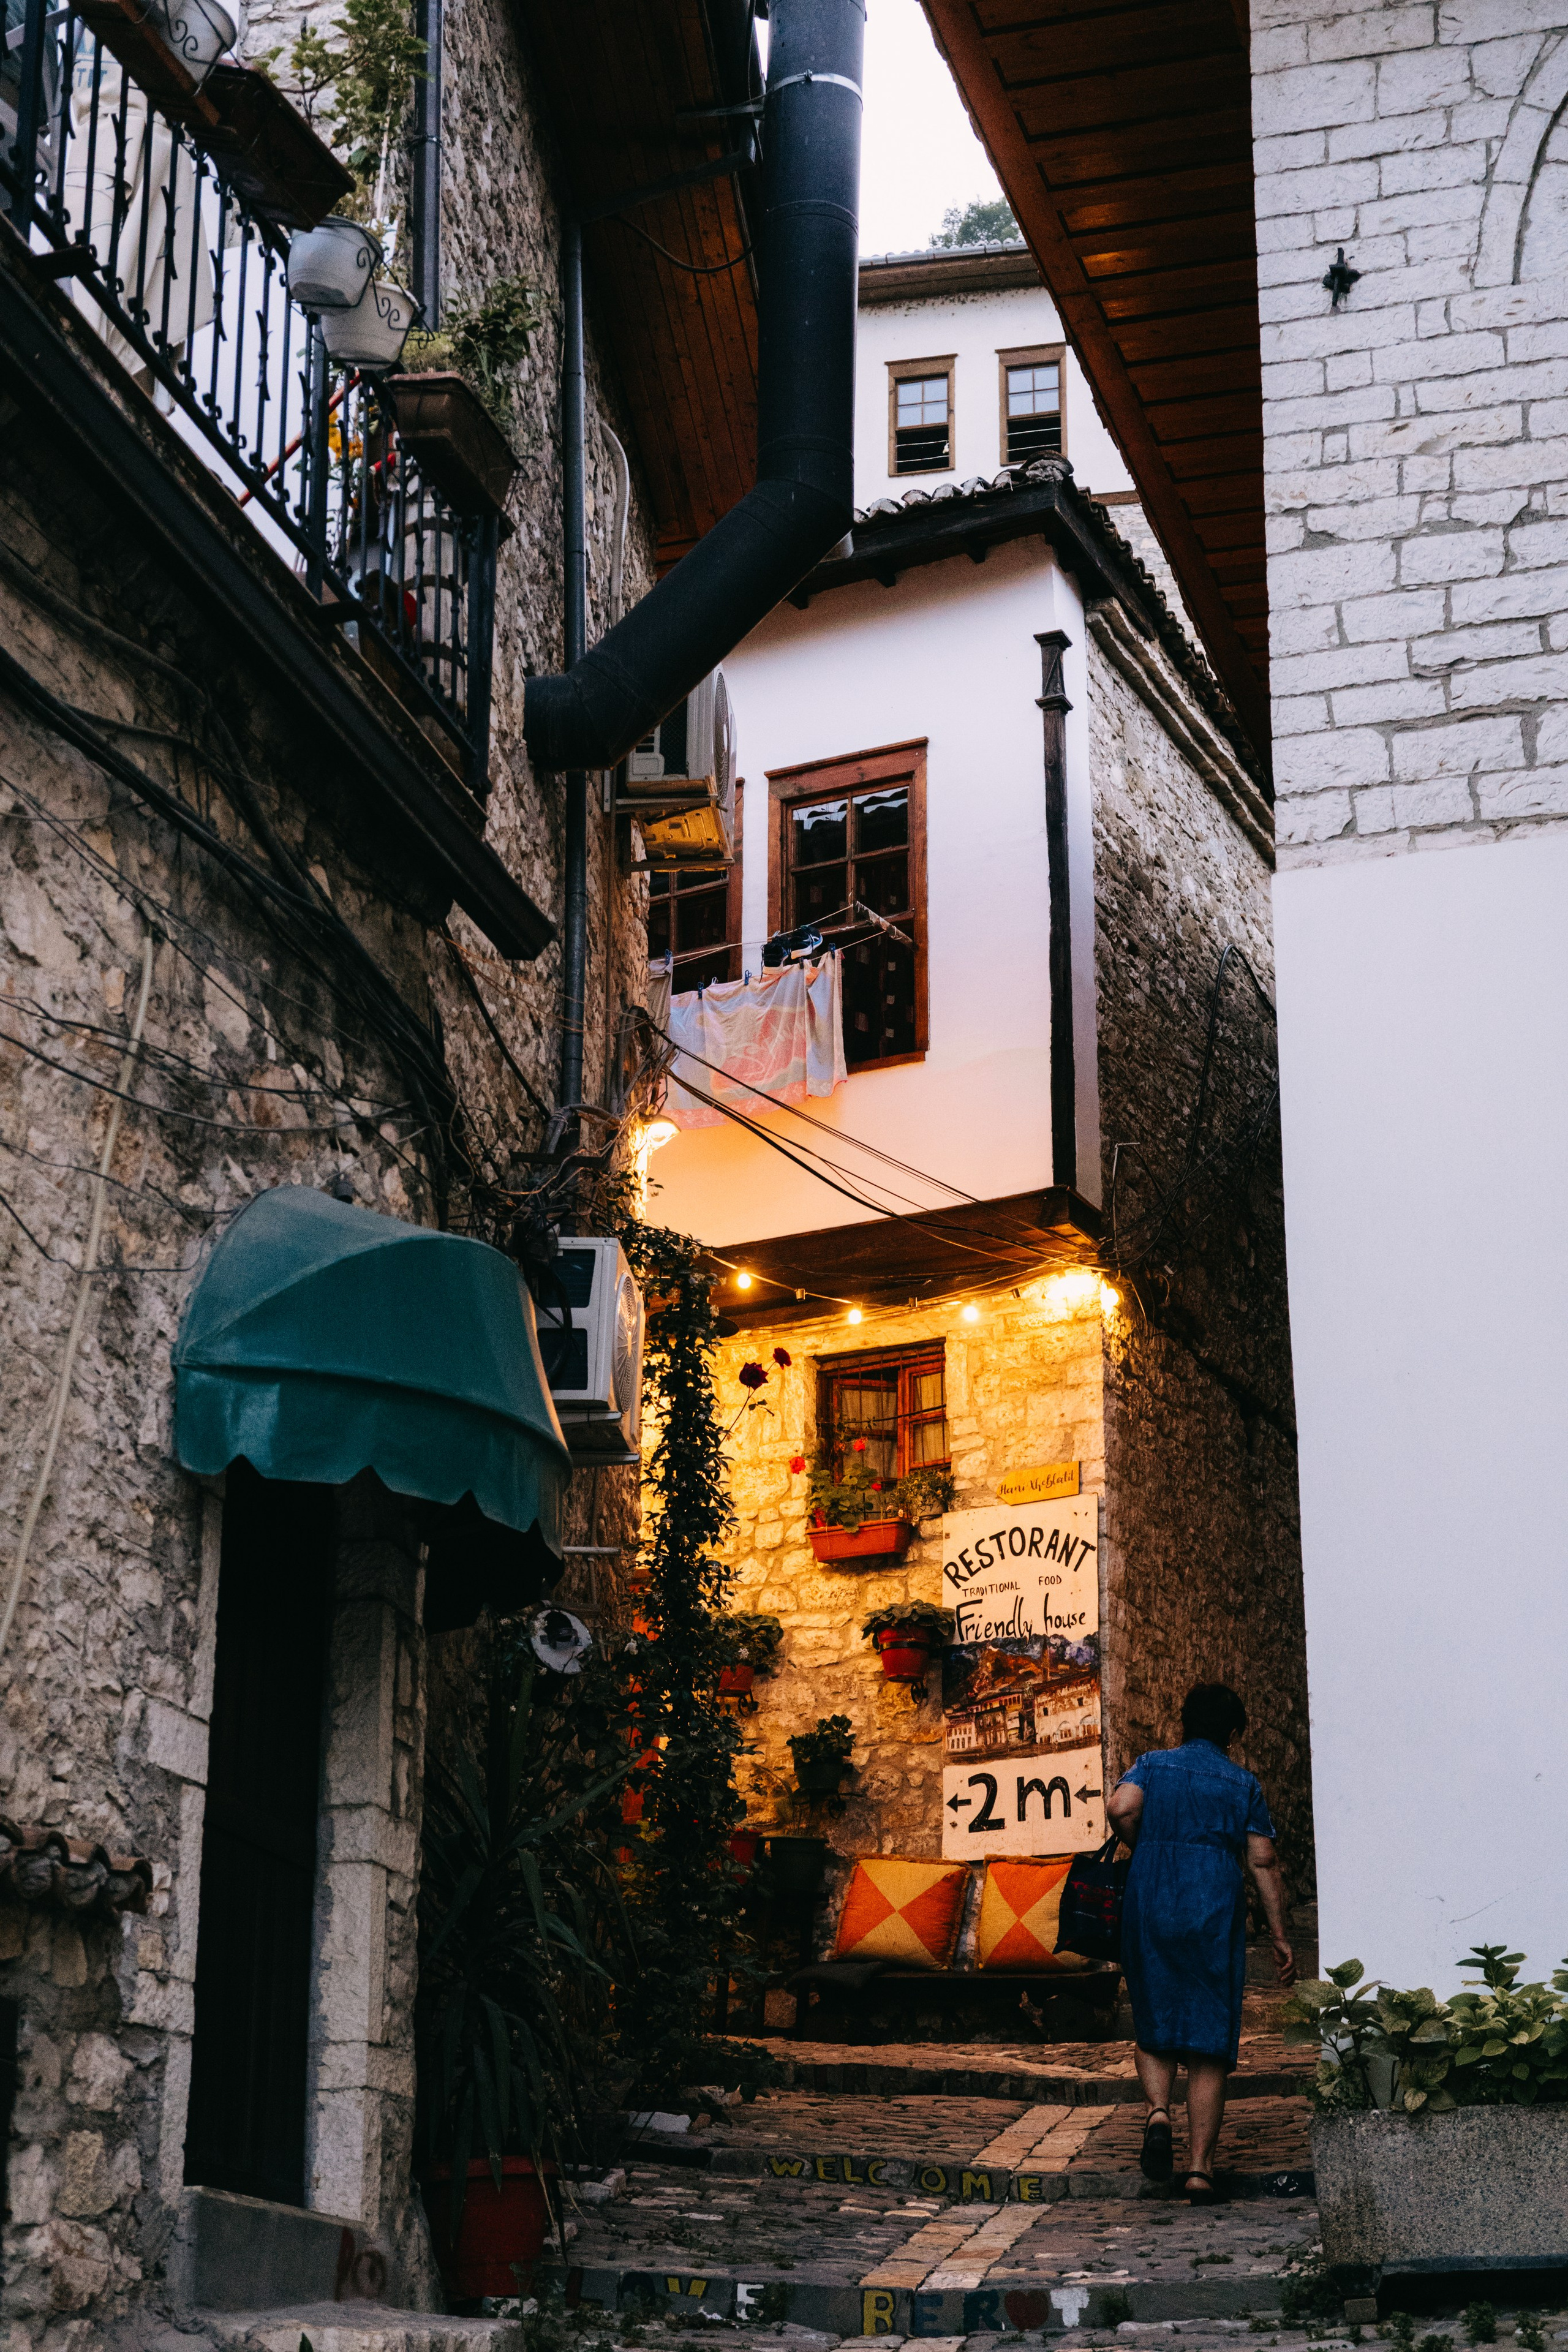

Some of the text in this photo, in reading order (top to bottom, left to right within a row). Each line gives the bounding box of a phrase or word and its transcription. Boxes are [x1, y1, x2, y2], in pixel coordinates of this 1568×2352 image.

[943, 1526, 1096, 1589] RESTORANT
[962, 1575, 1062, 1597] TRADITIONAL FOOD
[956, 1593, 1087, 1647] Friendly house
[968, 1773, 1071, 1833] 2 m
[769, 2155, 1043, 2203] WELCOME
